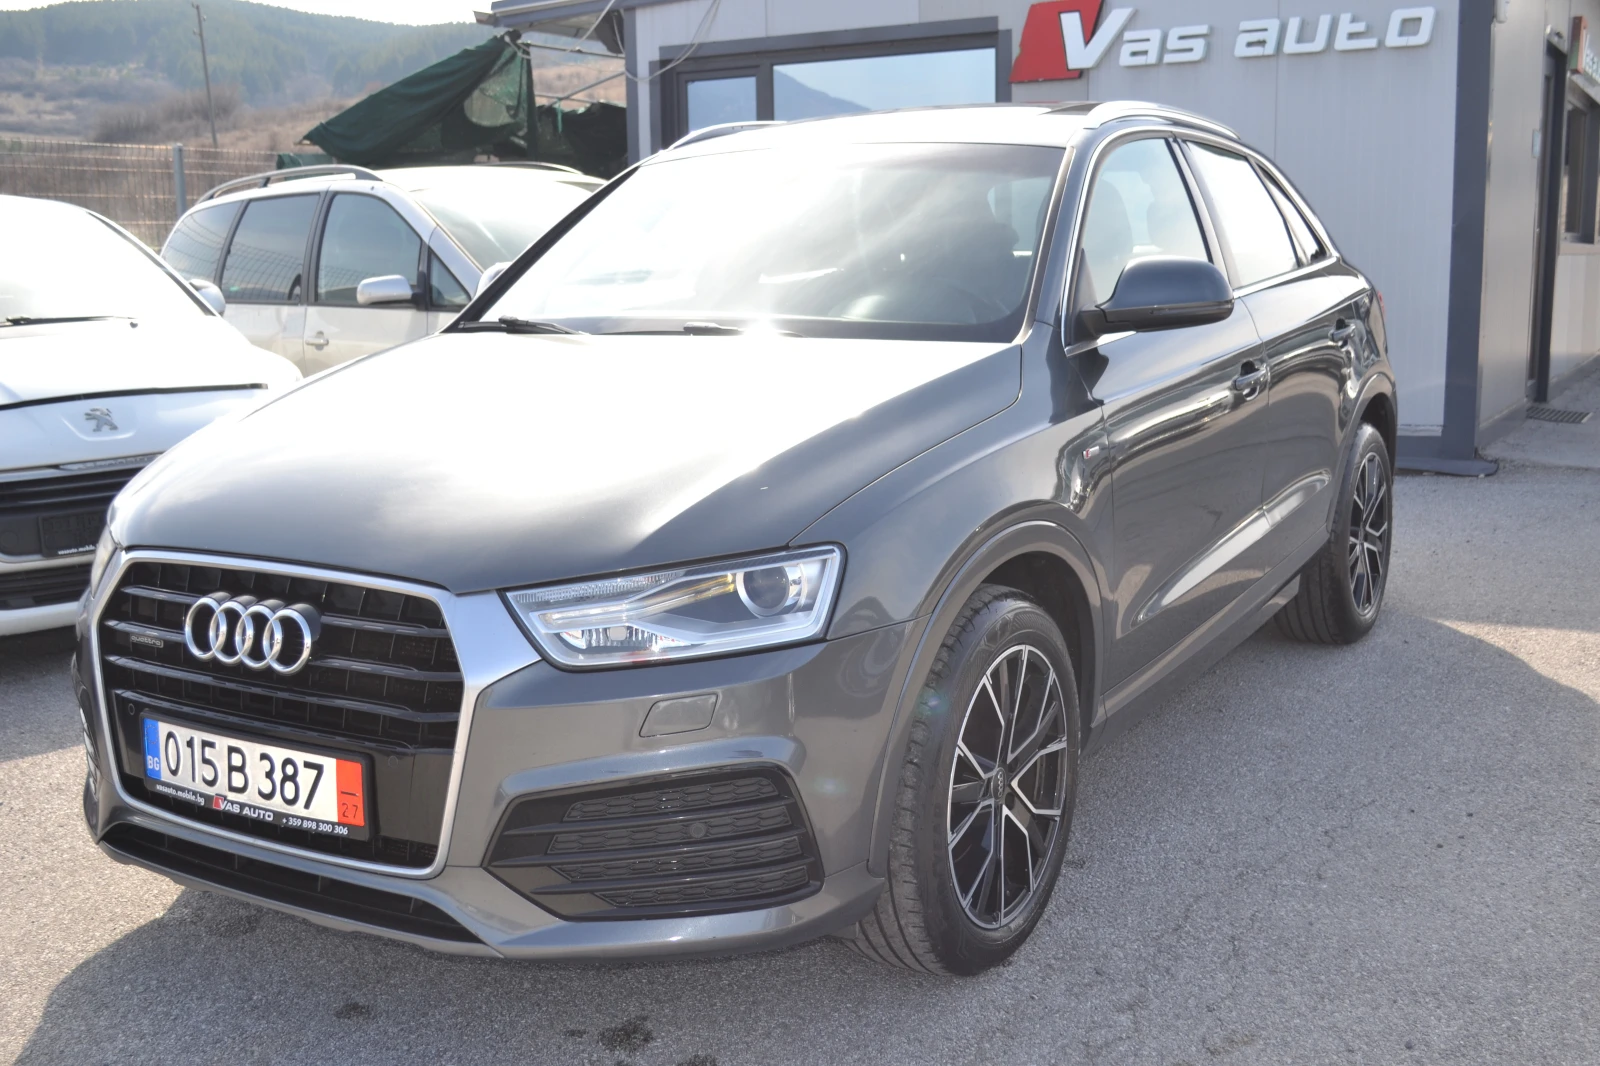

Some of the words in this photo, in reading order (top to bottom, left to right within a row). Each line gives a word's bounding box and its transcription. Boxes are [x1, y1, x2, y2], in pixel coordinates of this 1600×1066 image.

[131, 635, 161, 646] quattro
[147, 755, 160, 771] BG
[156, 783, 205, 806] vasauto.mobile.bg
[219, 798, 241, 813] VAS
[243, 806, 274, 821] AUTO
[341, 802, 359, 819] 27
[302, 819, 317, 830] 898
[318, 822, 333, 833] 300
[333, 825, 348, 835] 306
